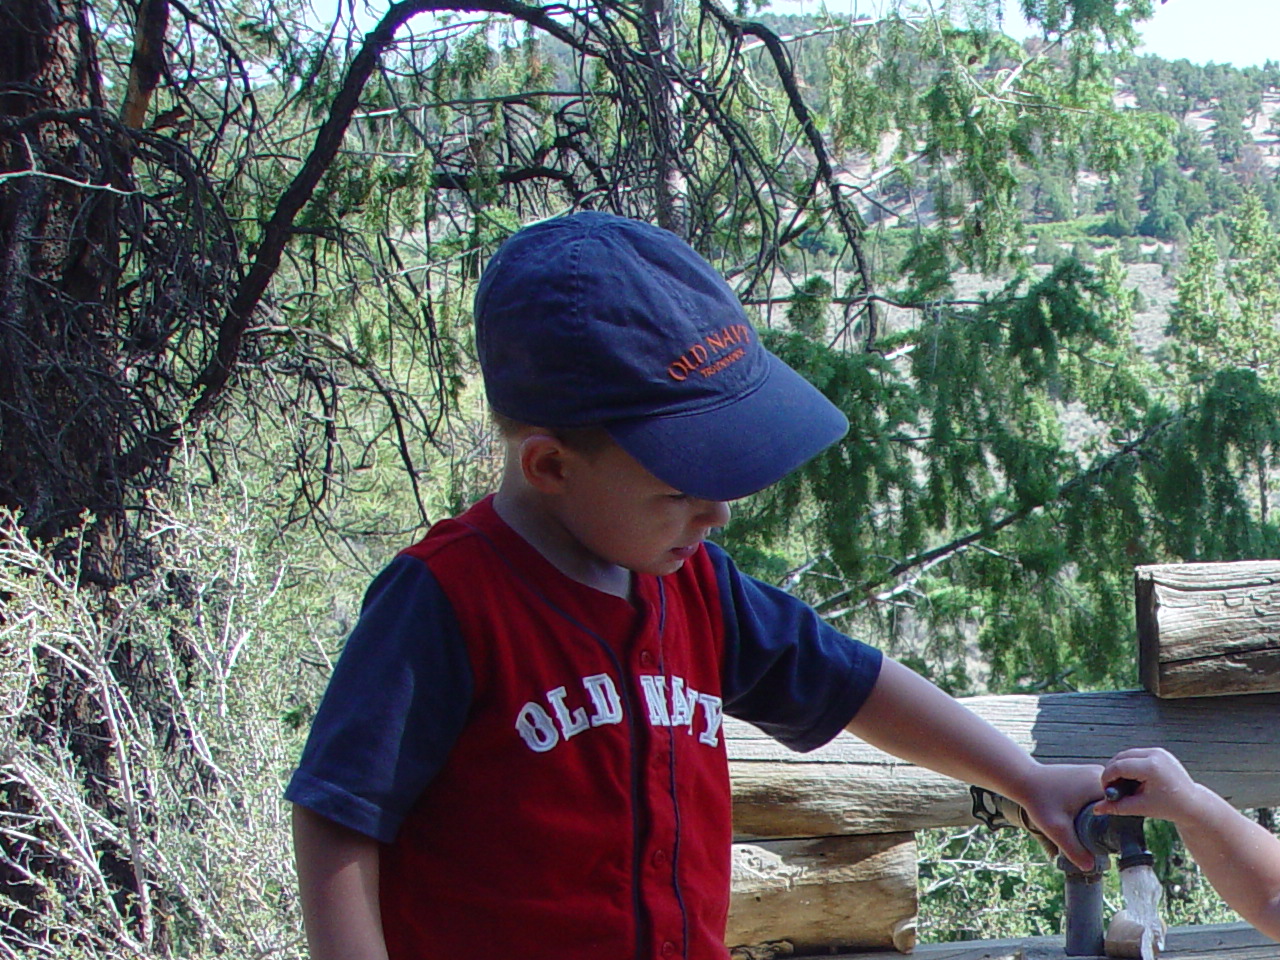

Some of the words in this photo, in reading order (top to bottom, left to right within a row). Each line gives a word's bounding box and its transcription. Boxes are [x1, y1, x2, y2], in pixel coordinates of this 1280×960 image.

[667, 344, 708, 381] OLD
[515, 672, 624, 753] OLD
[639, 674, 723, 748] NAVY
